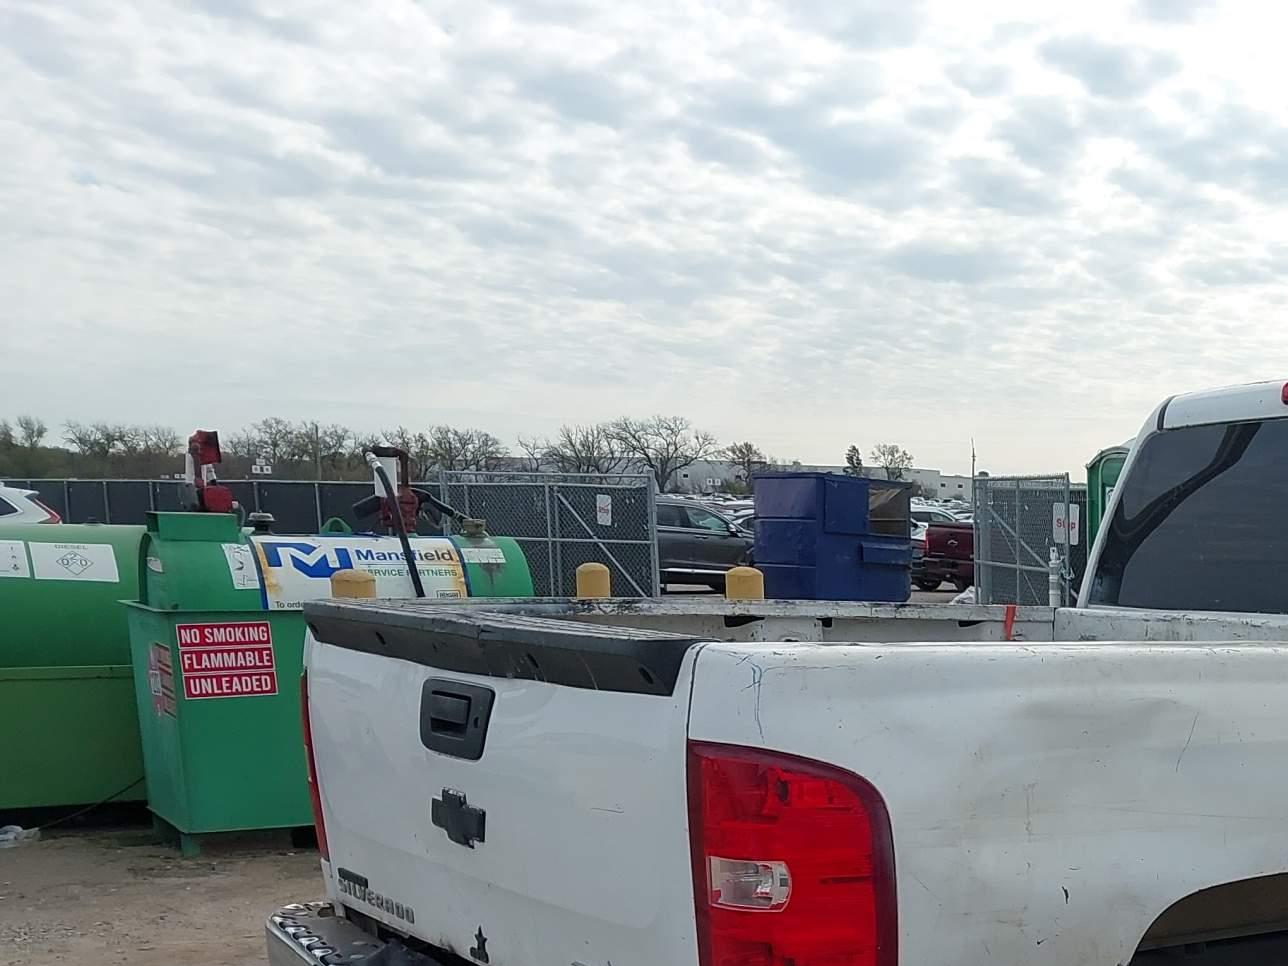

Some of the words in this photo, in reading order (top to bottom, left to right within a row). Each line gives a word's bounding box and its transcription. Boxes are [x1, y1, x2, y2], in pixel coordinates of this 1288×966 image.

[276, 600, 285, 608] To
[181, 628, 200, 643] NO
[204, 626, 268, 643] SMOKING
[183, 650, 272, 669] FLAMMABLE
[189, 675, 271, 695] UNLEADED
